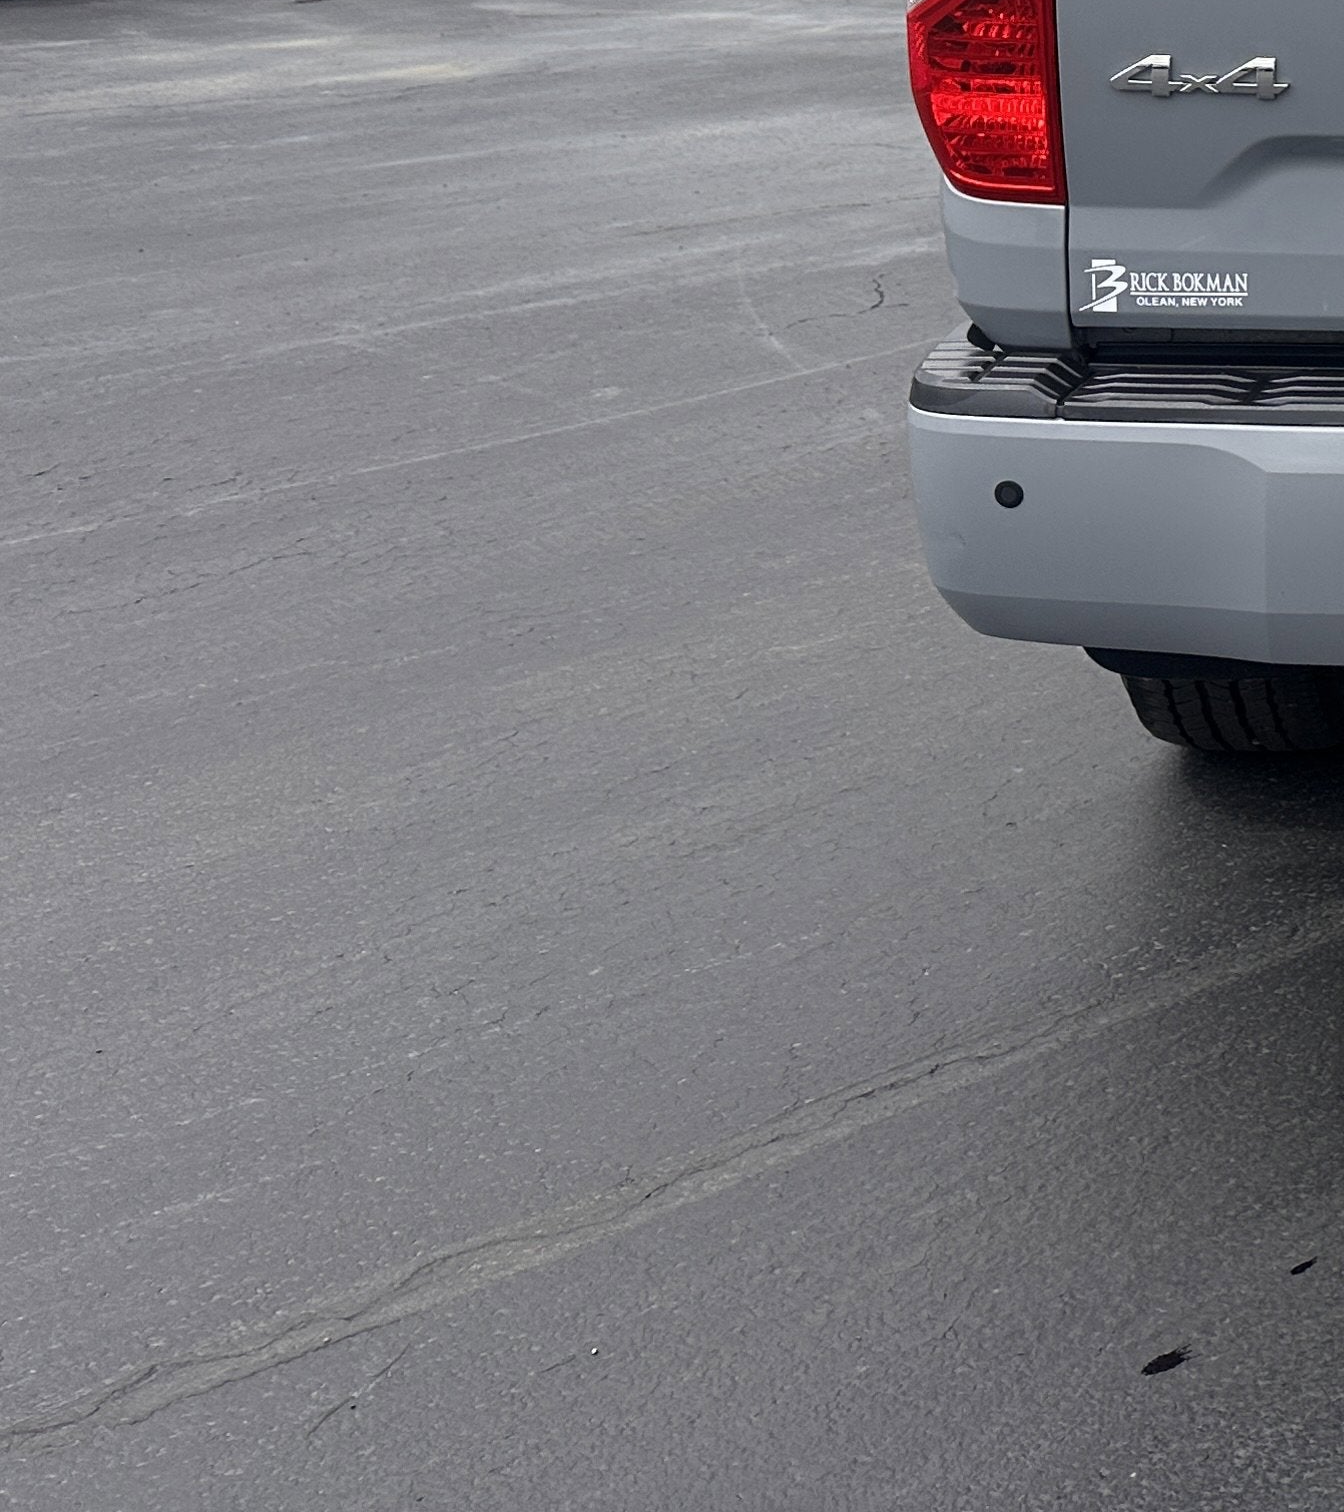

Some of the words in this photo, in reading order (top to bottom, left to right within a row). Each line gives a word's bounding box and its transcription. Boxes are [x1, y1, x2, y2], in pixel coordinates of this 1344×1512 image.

[1109, 54, 1291, 100] 4x4
[1130, 272, 1168, 291] RICK
[1172, 273, 1248, 292] BOKMAN
[1136, 296, 1179, 307] OLEAN,
[1181, 297, 1208, 306] NEW
[1211, 297, 1243, 307] YORK
